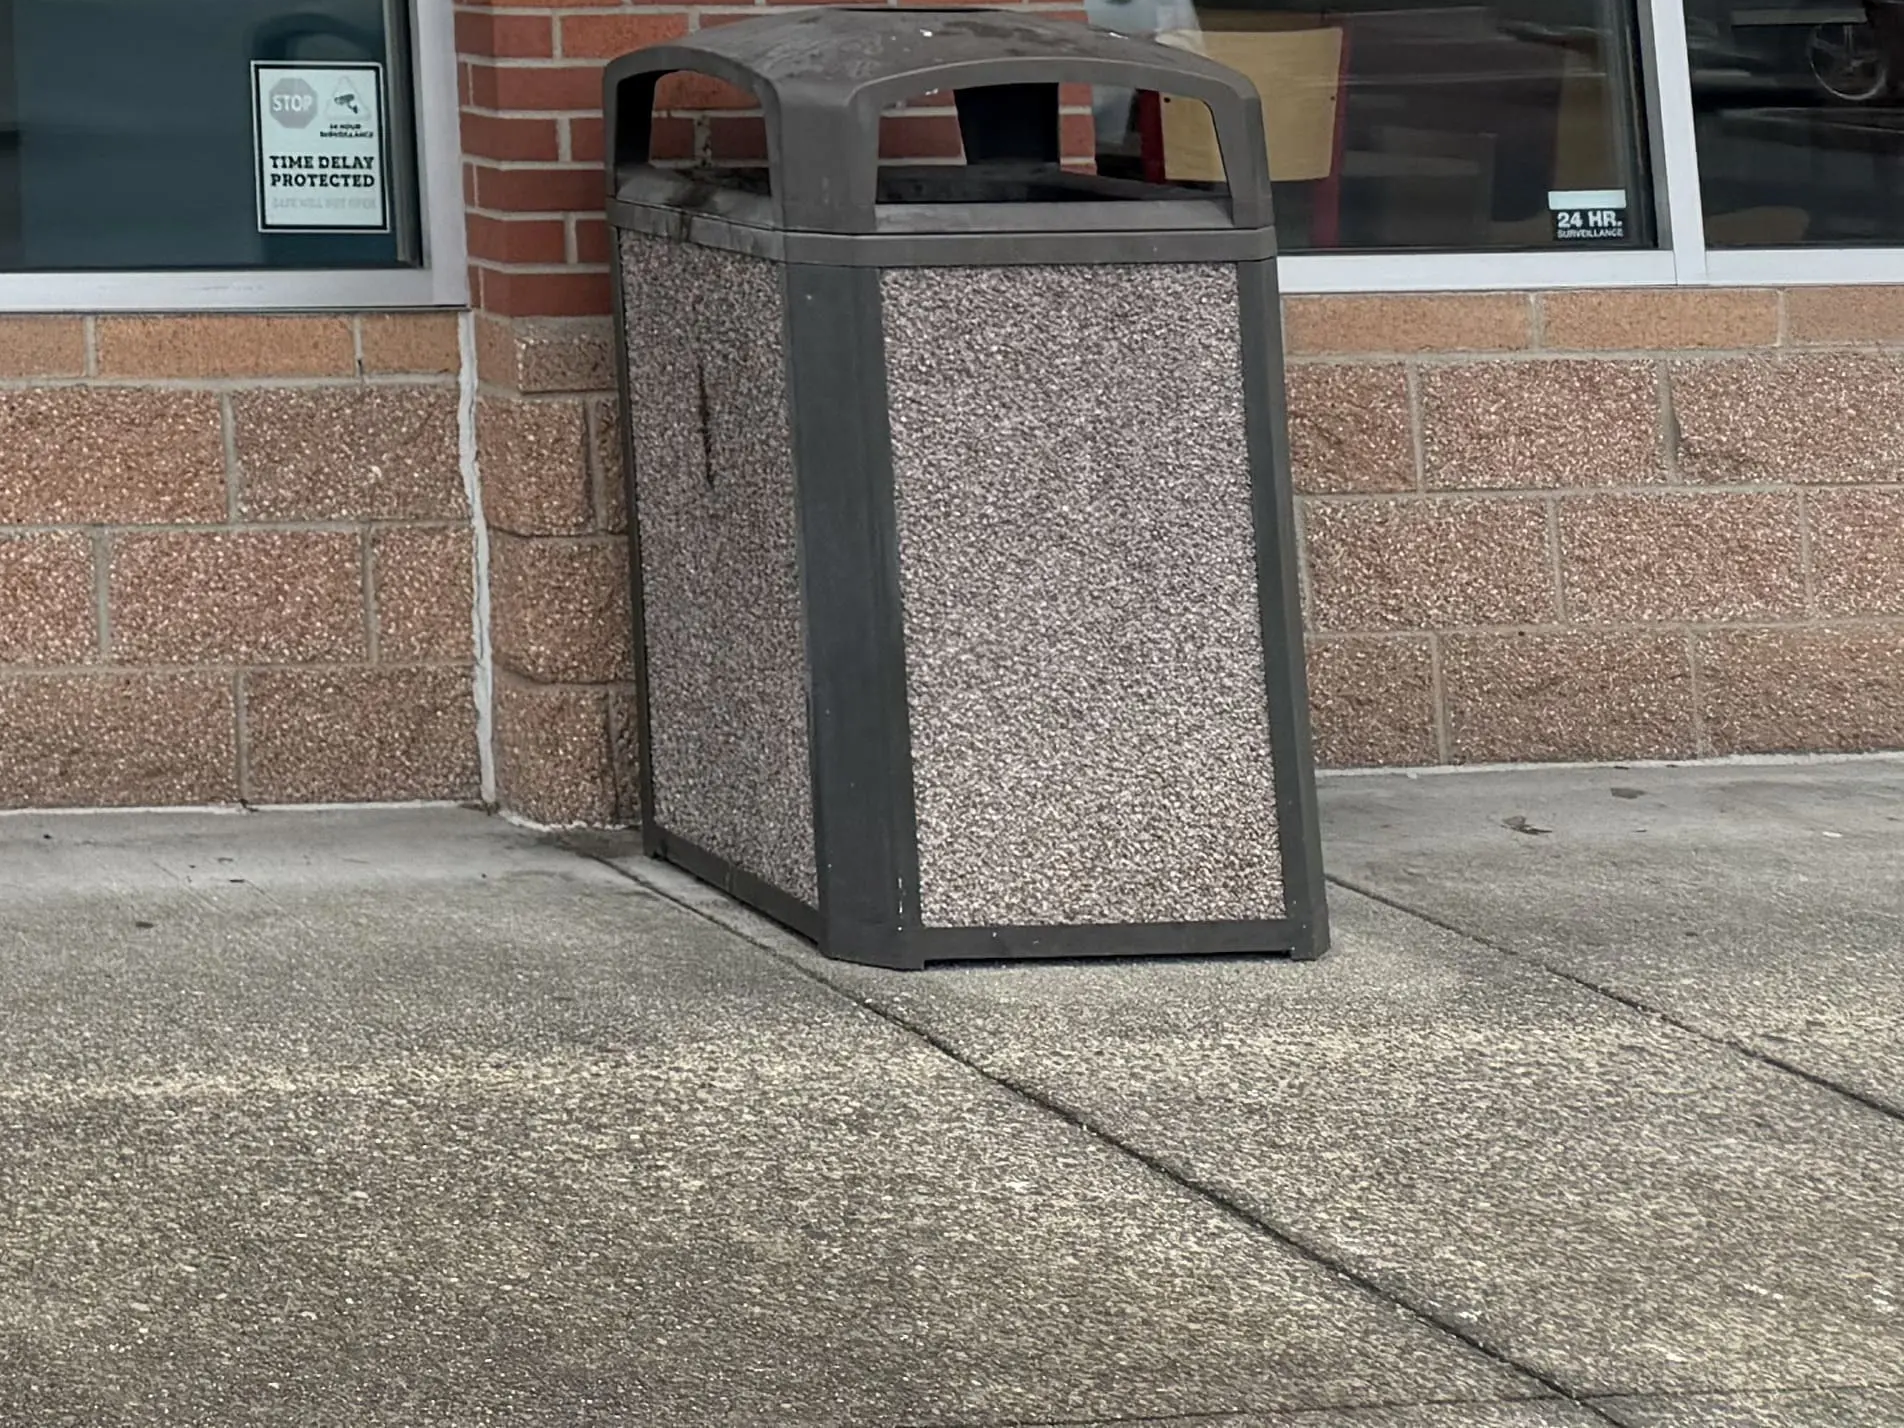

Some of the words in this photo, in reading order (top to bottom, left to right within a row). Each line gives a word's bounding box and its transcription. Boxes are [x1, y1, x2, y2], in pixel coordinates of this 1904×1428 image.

[271, 94, 313, 113] STOP
[269, 155, 314, 169] TIME
[318, 156, 375, 170] DELAY
[270, 173, 375, 188] PROTECTED
[1556, 211, 1583, 229] 24
[1587, 210, 1623, 228] HR.
[1556, 228, 1624, 239] SURVEILLANCE
